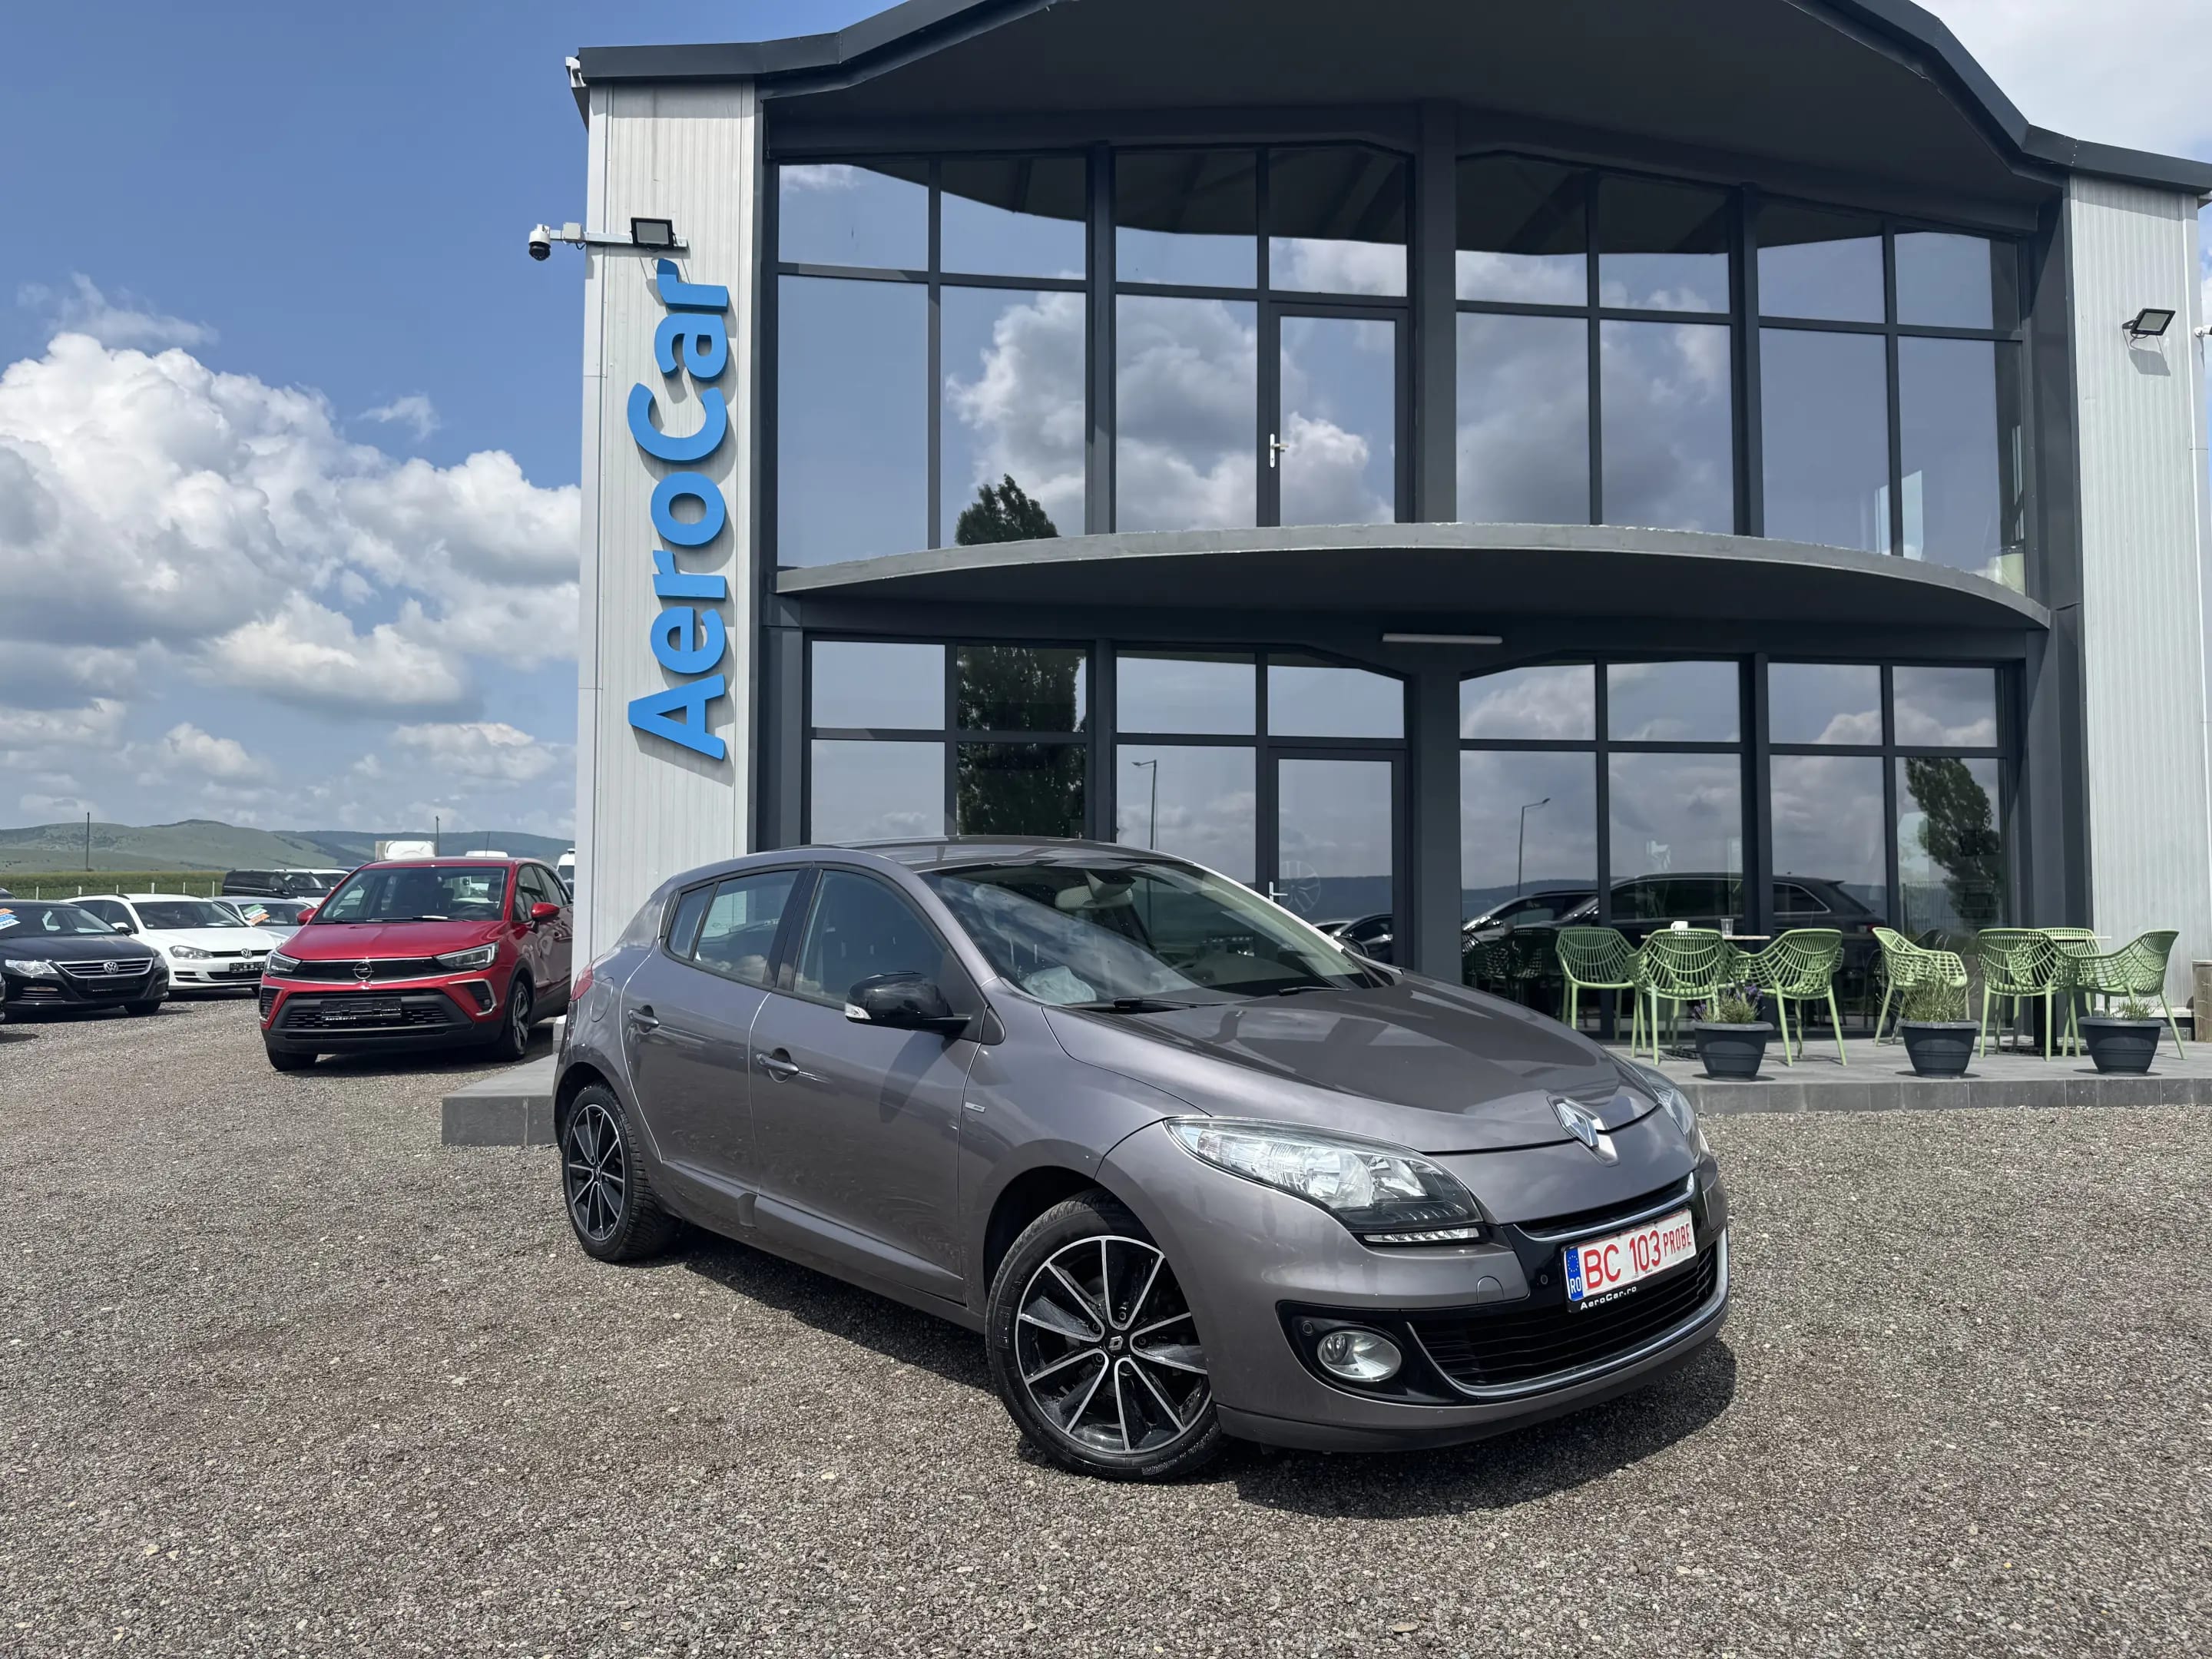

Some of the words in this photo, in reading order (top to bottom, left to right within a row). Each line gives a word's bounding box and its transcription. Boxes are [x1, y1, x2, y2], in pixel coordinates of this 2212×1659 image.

[628, 258, 729, 760] AeroCar
[1583, 1243, 1621, 1290] BC
[1629, 1230, 1661, 1273] 103
[1663, 1223, 1691, 1257] PROBE
[1569, 1277, 1582, 1294] RO
[1580, 1286, 1637, 1311] AeroCar.ro
